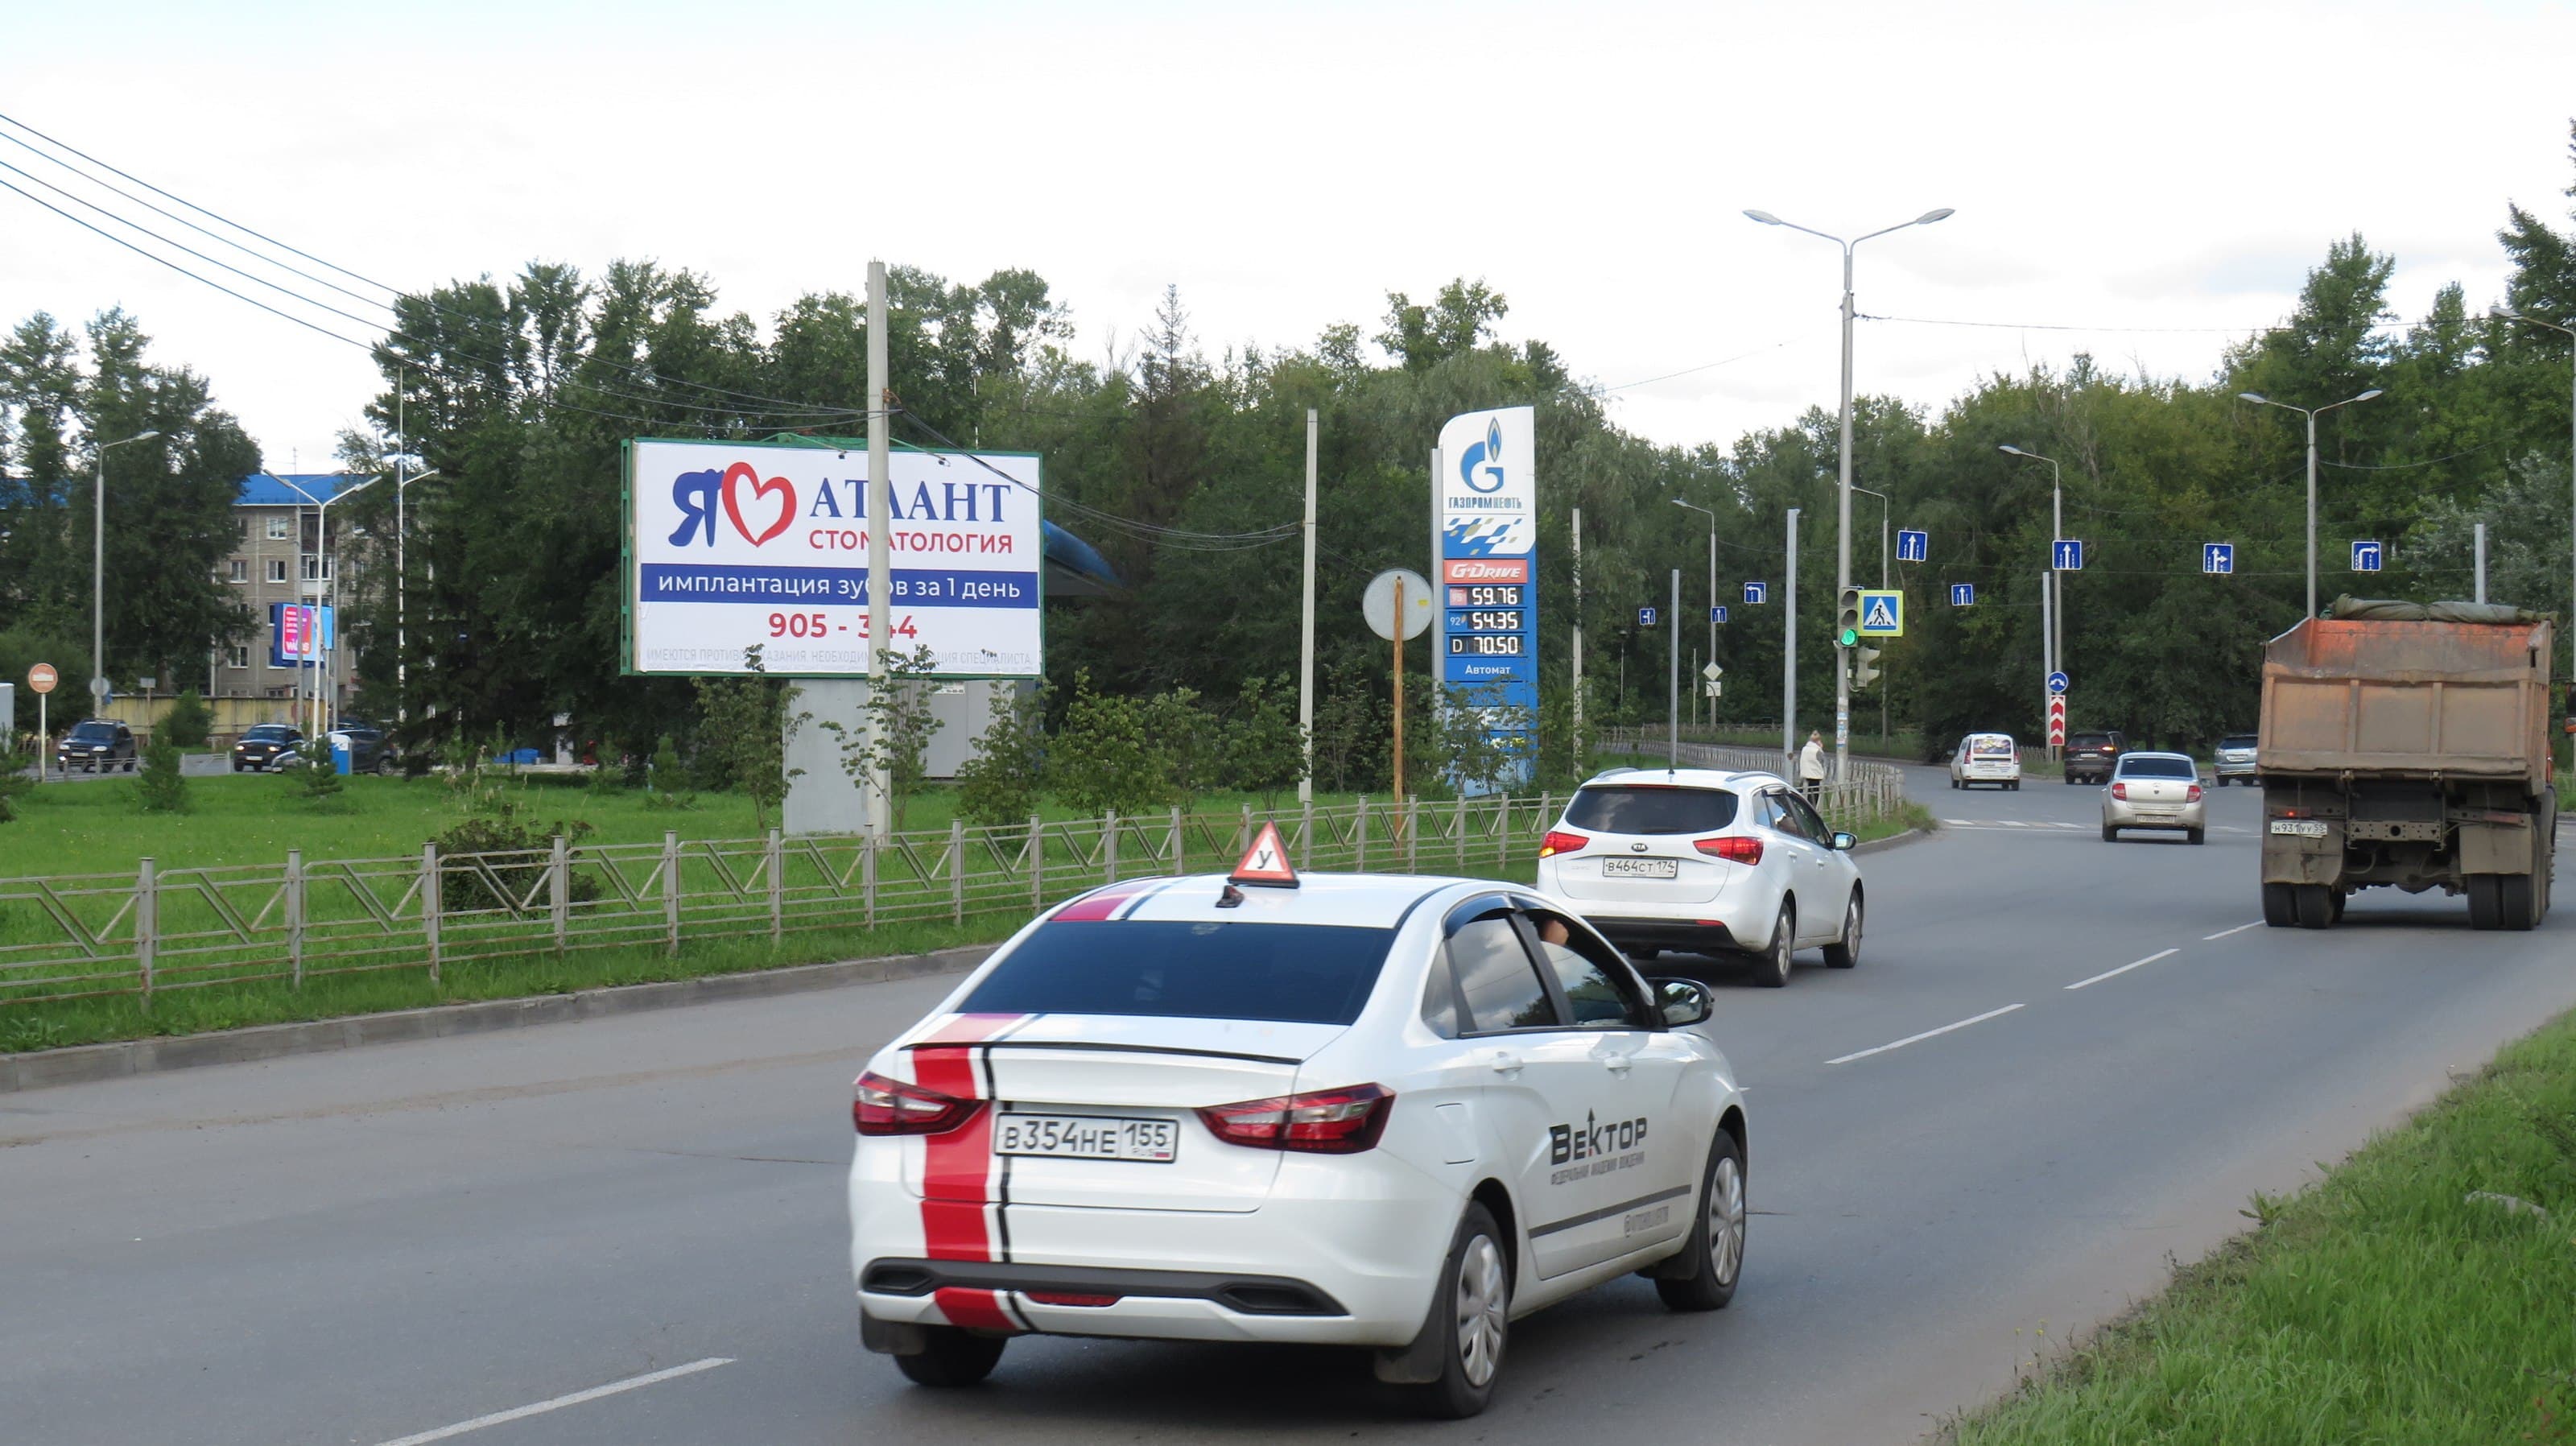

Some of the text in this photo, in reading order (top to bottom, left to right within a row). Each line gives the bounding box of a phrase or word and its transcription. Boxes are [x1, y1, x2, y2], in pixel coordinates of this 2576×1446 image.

[668, 469, 724, 547] Я
[1448, 497, 1522, 509] ГАЗПРОМНЕФТЬ
[658, 576, 1021, 600] имплантация зув за 1 день
[1472, 588, 1517, 605] 59.76
[769, 613, 828, 638] 905
[1450, 612, 1518, 630] 92 54.35
[646, 648, 696, 661] ИМЕЮТСЯ
[1452, 637, 1518, 655] D 70.50
[1608, 860, 1674, 872] В464СТ 174
[1005, 1120, 1169, 1154] В354НЕ 155
